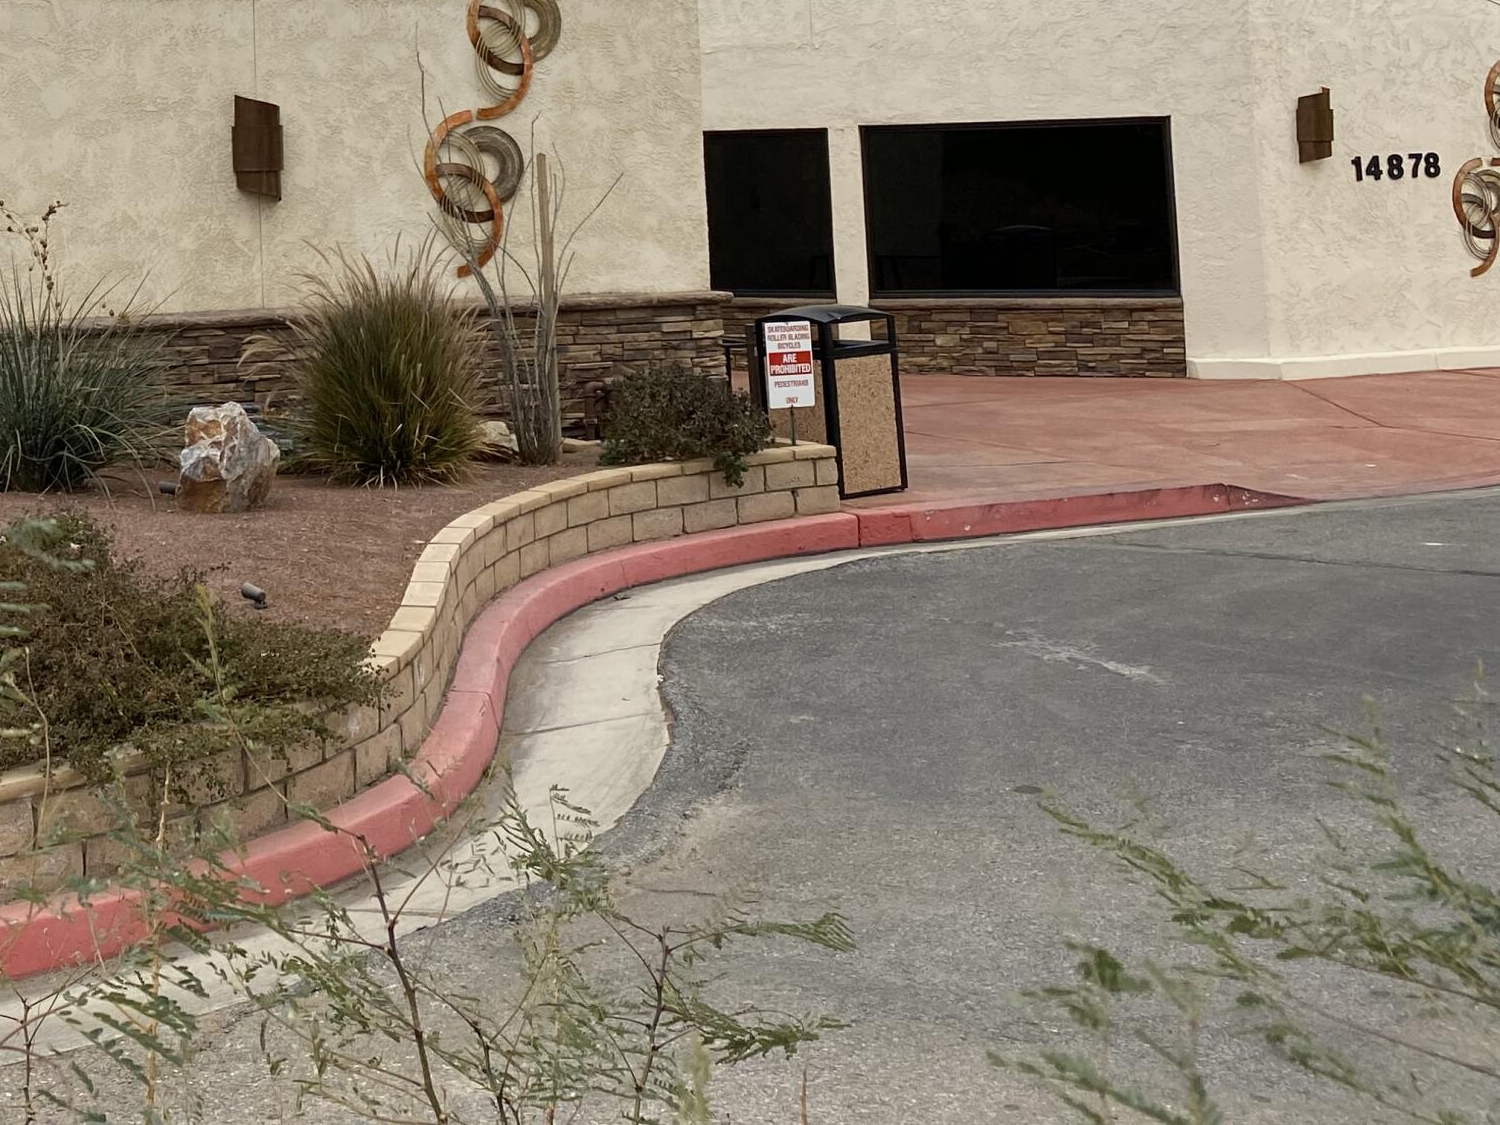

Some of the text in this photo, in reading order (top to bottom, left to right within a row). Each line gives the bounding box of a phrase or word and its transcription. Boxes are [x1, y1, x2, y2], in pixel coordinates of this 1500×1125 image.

[1351, 152, 1441, 182] 14878
[782, 353, 798, 364] ARE
[770, 363, 811, 375] PROHIBITED
[774, 379, 809, 387] PEDESTRIANS
